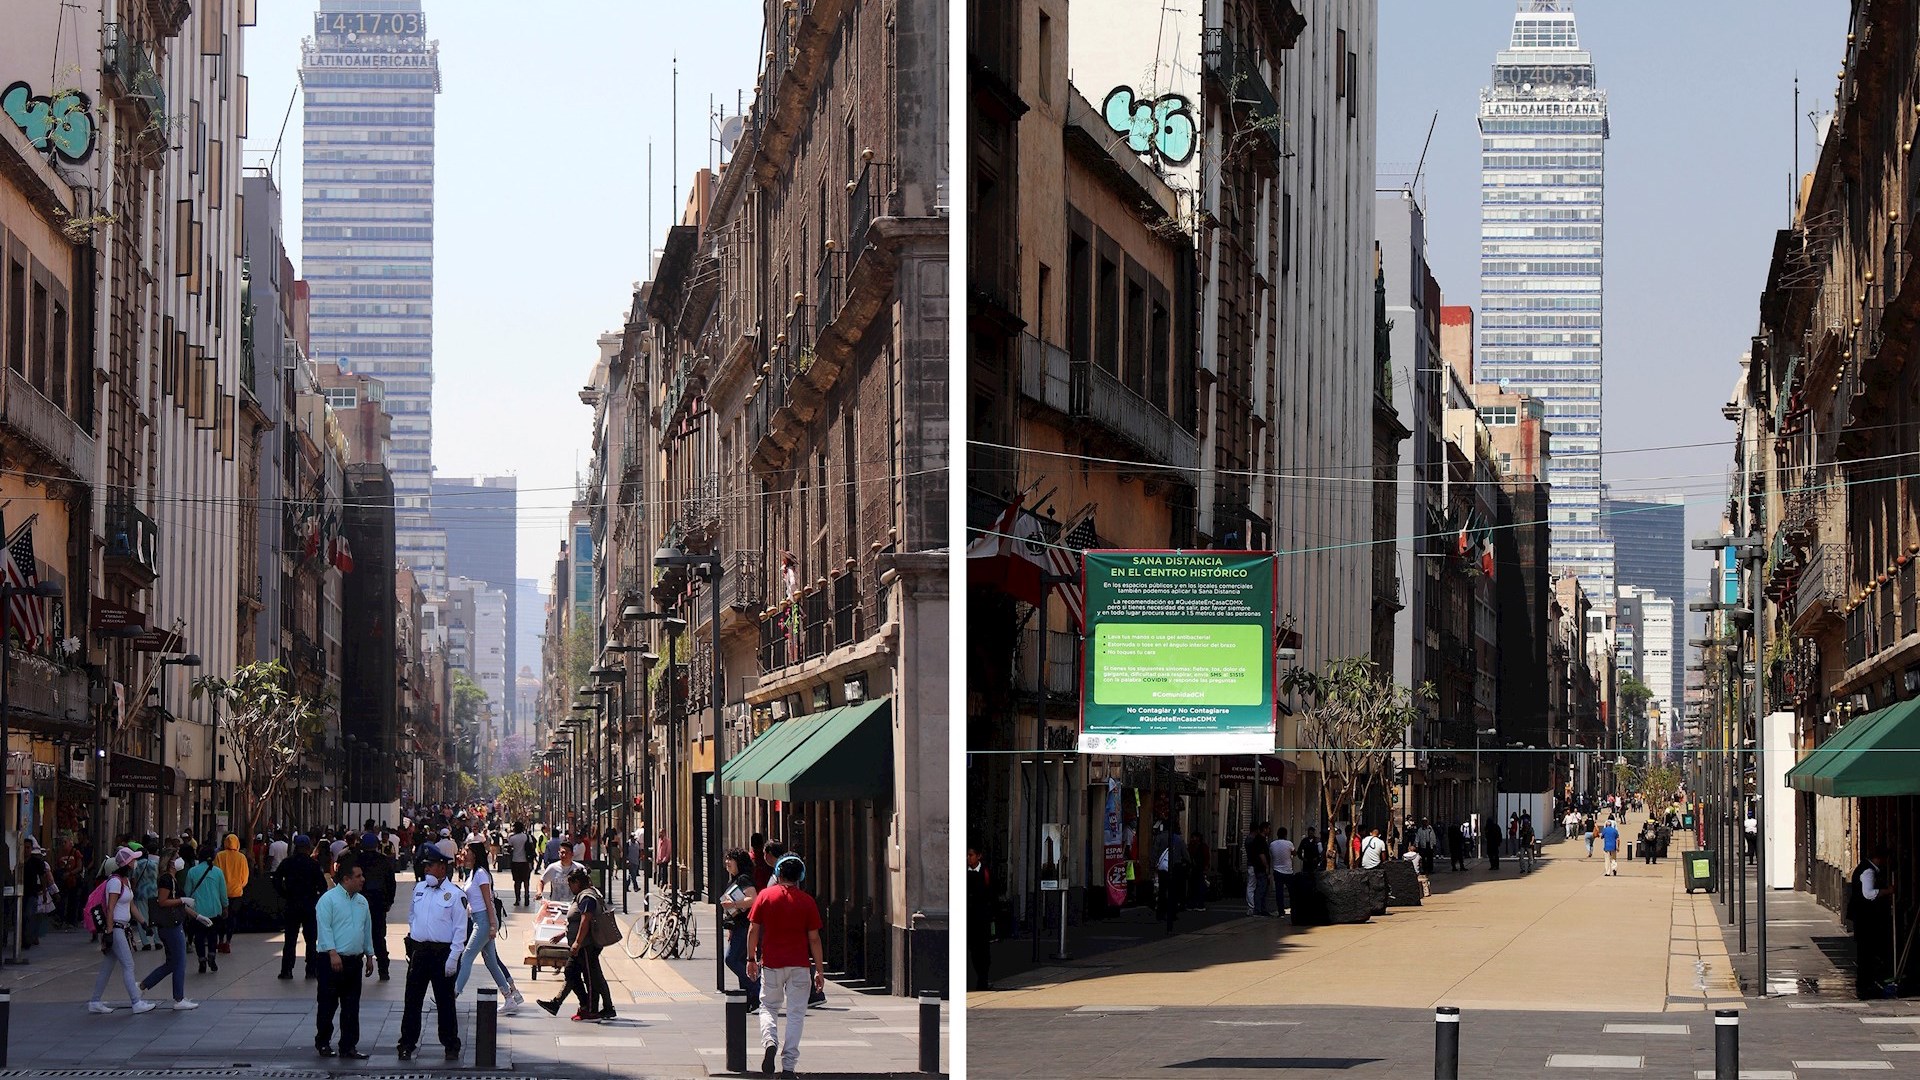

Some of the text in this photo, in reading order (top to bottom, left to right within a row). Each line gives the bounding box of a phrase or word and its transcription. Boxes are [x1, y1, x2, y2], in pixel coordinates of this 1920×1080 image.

[320, 14, 418, 34] 14:17:03
[310, 55, 428, 66] LATINOAMERICANA
[1488, 104, 1596, 115] LATINOAMERICANA
[1133, 557, 1223, 565] SANA DISTANCIA
[1111, 567, 1248, 577] EN EL CENTRO HISTÓRICO
